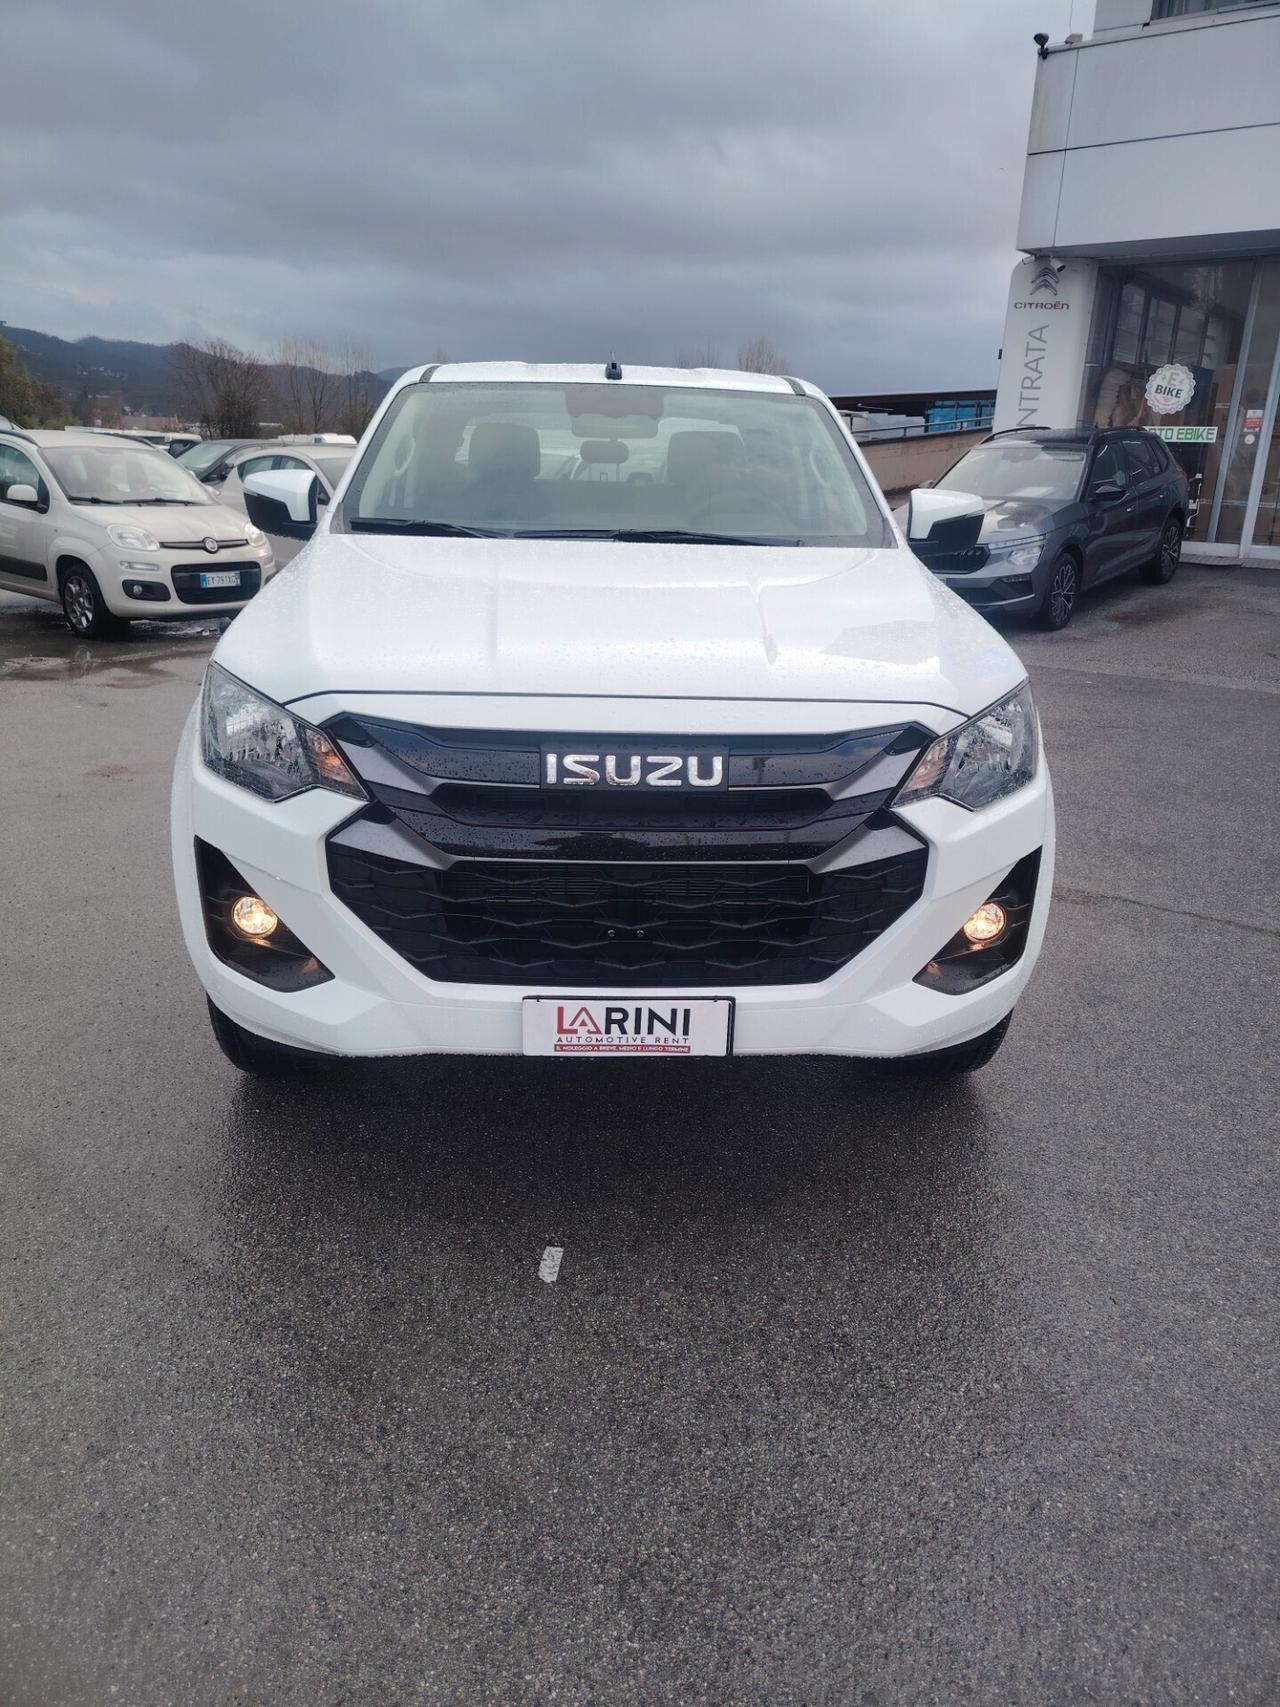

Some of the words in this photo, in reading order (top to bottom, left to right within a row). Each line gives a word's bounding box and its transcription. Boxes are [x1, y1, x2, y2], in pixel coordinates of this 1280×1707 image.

[1015, 324, 1050, 428] NTRATA
[1155, 384, 1184, 398] BIKE
[1176, 428, 1216, 440] EBIKE
[546, 753, 723, 787] ISUZU
[557, 1006, 691, 1036] LARINI
[557, 1036, 646, 1044] AUTOMOTIVE
[655, 1037, 689, 1045] RENT
